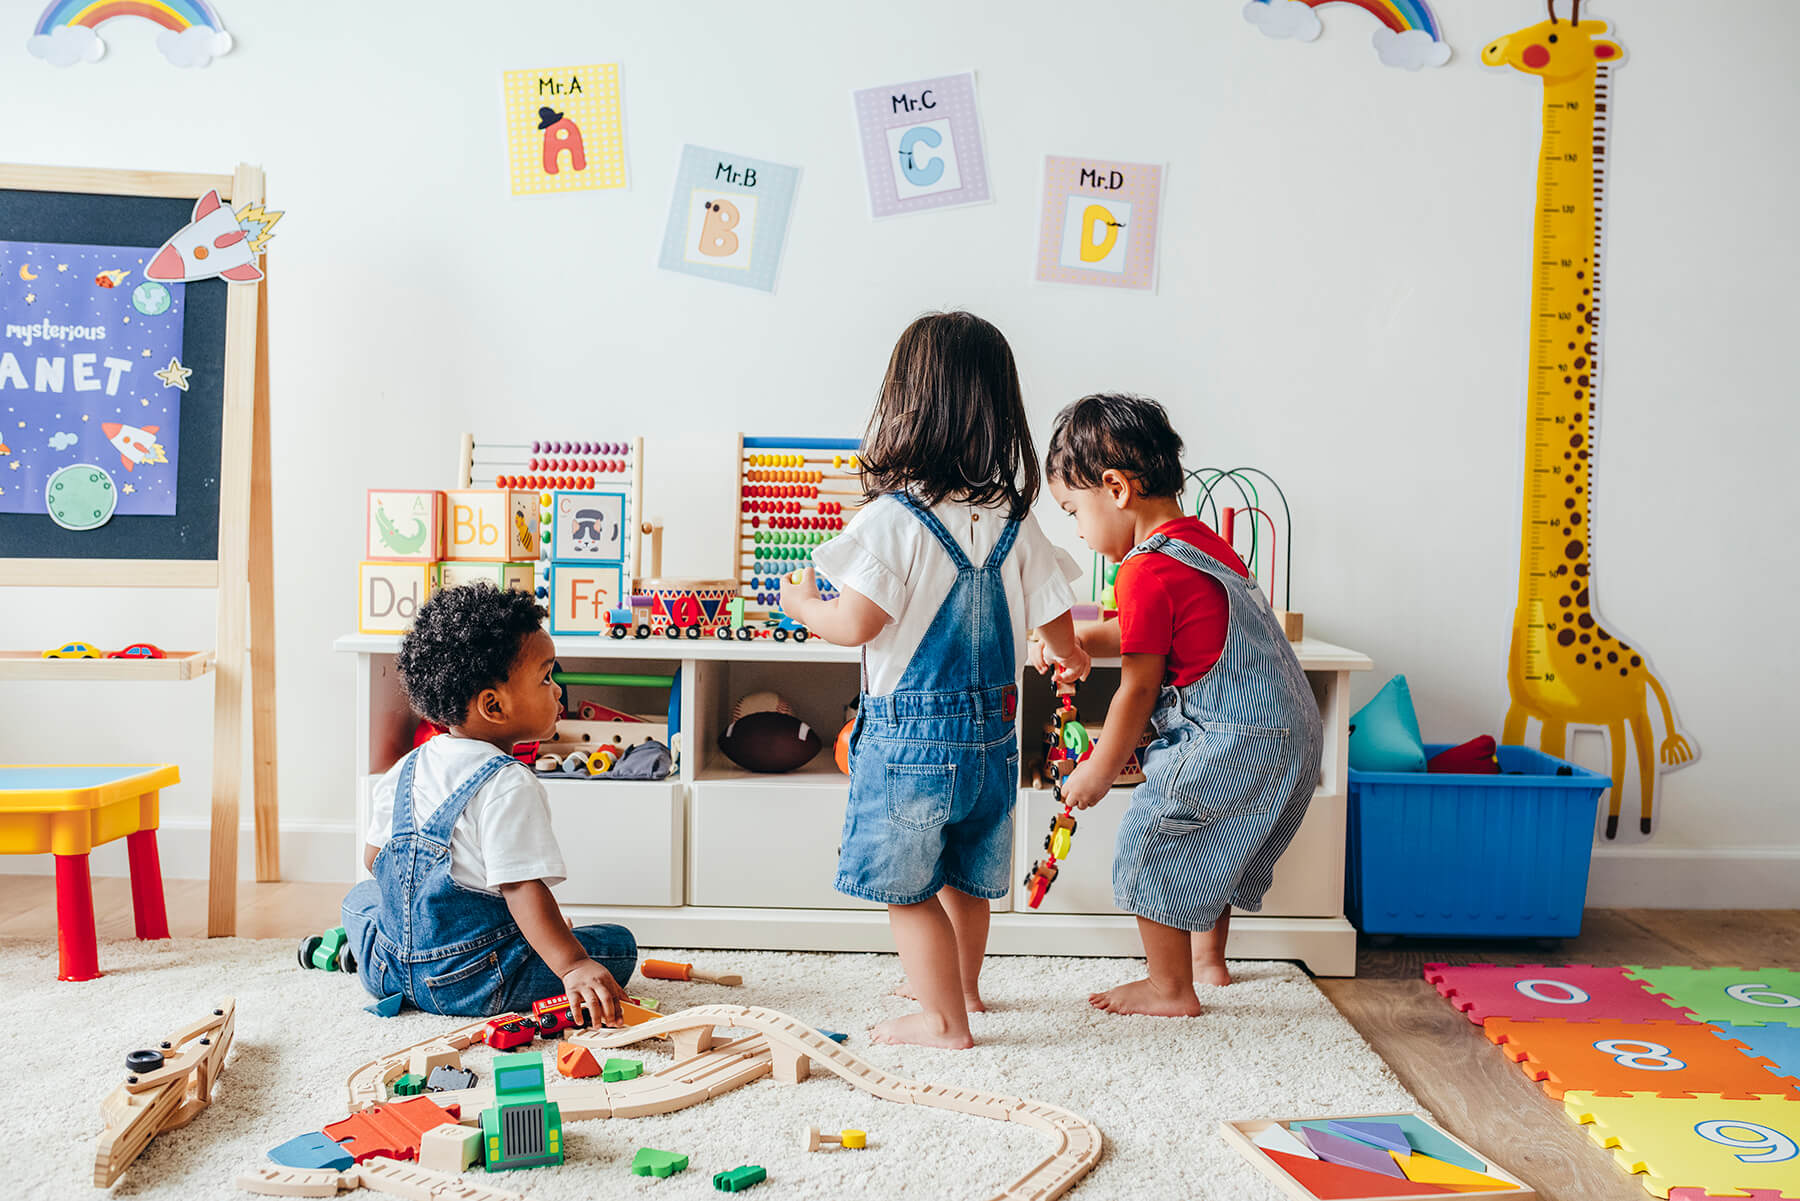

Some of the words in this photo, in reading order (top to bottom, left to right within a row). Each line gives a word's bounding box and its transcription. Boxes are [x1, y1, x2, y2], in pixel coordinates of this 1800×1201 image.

[538, 75, 583, 96] Mr.A
[891, 90, 937, 114] Mr.C
[542, 117, 587, 175] A
[898, 126, 945, 187] C
[715, 162, 758, 187] Mr.B
[1079, 168, 1124, 191] Mr.D
[698, 198, 740, 257] B
[1079, 204, 1119, 263] D
[6, 317, 107, 347] mysterious
[1558, 312, 1572, 321] 100
[560, 497, 572, 513] C
[453, 504, 498, 546] Bb
[369, 576, 418, 618] Dd
[571, 578, 607, 620] Ff
[725, 597, 745, 630] 1
[1514, 978, 1591, 1004] 0
[1724, 983, 1800, 1008] 6
[1592, 1039, 1688, 1071] 8
[1693, 1119, 1800, 1163] 9
